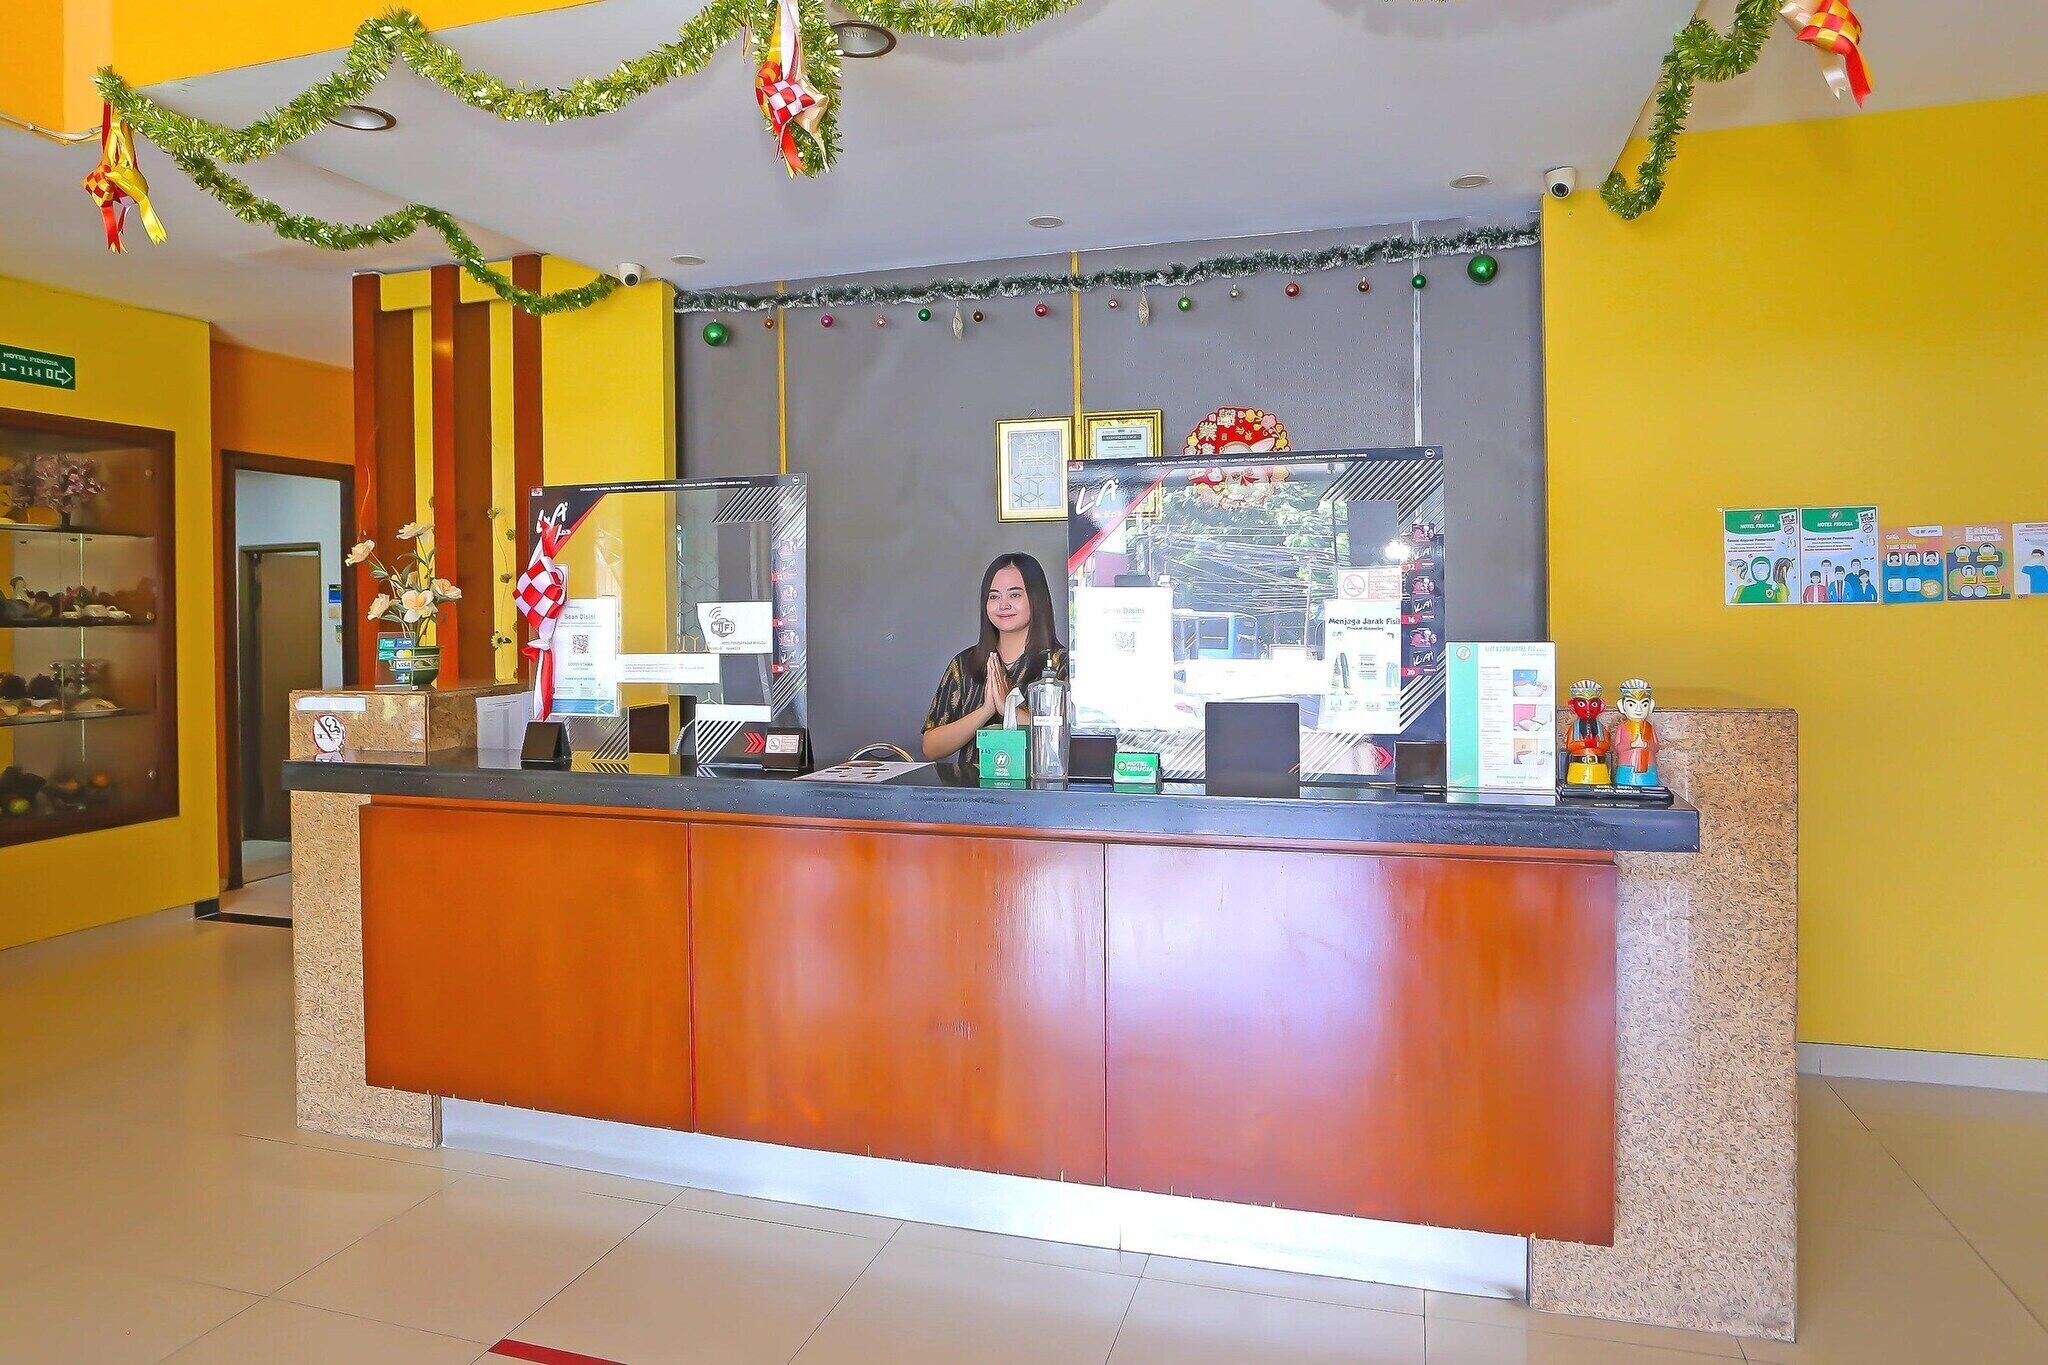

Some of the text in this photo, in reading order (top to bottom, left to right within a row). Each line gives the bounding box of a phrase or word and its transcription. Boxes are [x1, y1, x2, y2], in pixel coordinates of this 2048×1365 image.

[3, 352, 59, 367] HOTEL FIDUCIA
[1328, 617, 1360, 627] Menjaga
[1362, 617, 1384, 625] Jarak
